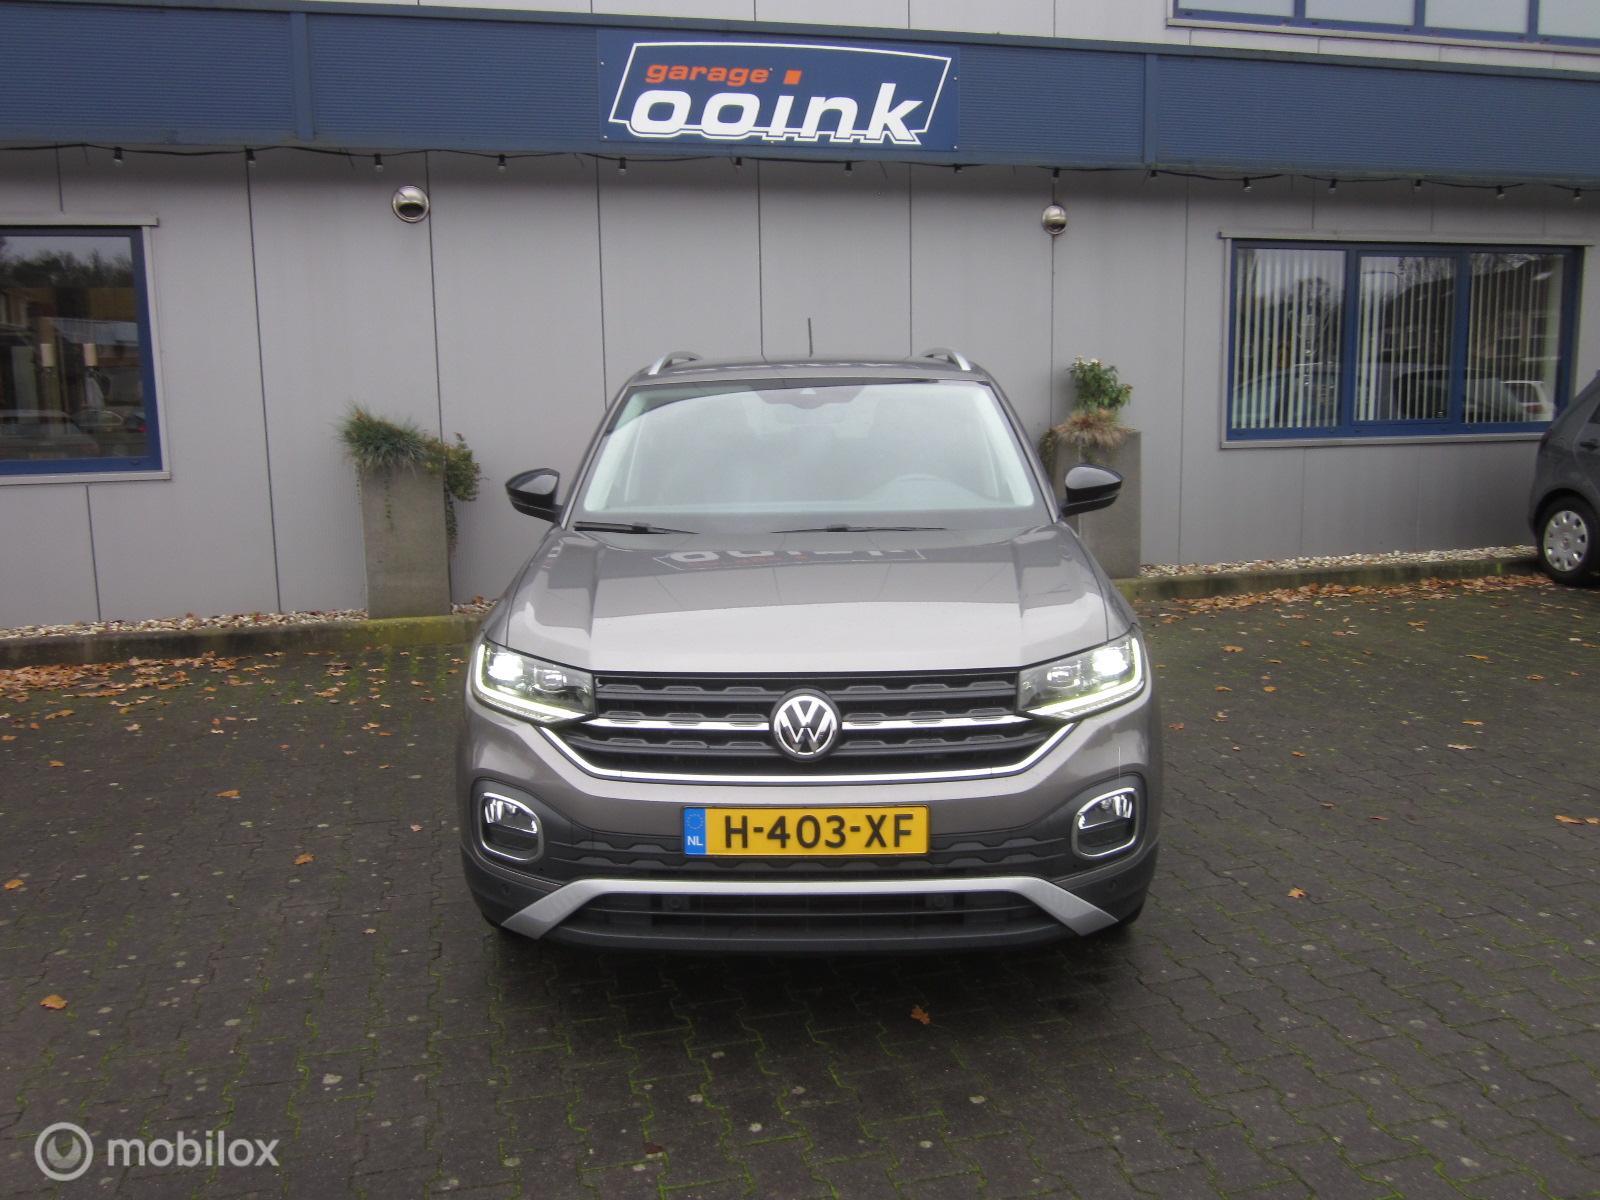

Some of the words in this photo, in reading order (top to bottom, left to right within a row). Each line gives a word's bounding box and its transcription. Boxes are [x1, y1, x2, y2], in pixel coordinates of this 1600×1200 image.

[645, 63, 771, 87] garage
[630, 71, 924, 141] ooink
[687, 835, 704, 846] NL
[724, 814, 914, 849] H-403-XF
